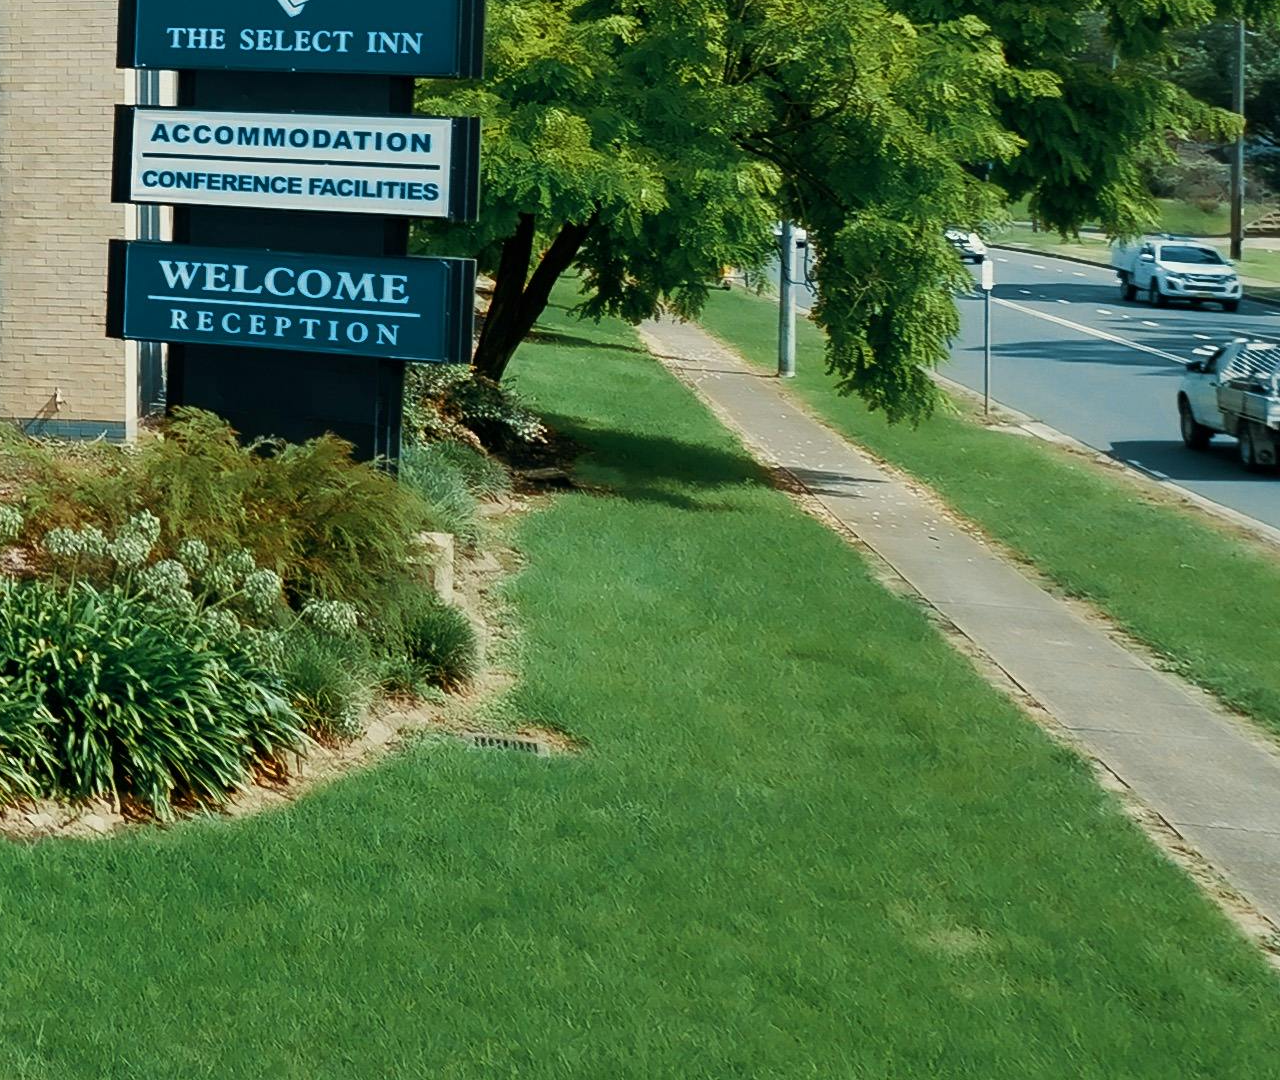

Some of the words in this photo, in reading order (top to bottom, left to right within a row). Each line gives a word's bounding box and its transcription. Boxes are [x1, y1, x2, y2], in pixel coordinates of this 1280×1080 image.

[166, 27, 226, 49] THE
[239, 28, 354, 53] SELECT
[366, 31, 424, 55] INN
[150, 123, 432, 153] ACCOMMODATION
[141, 170, 302, 195] CONFERENCE
[308, 177, 440, 202] FACILITIES
[158, 260, 410, 305] WELCOME
[169, 308, 400, 346] RECEPTION
